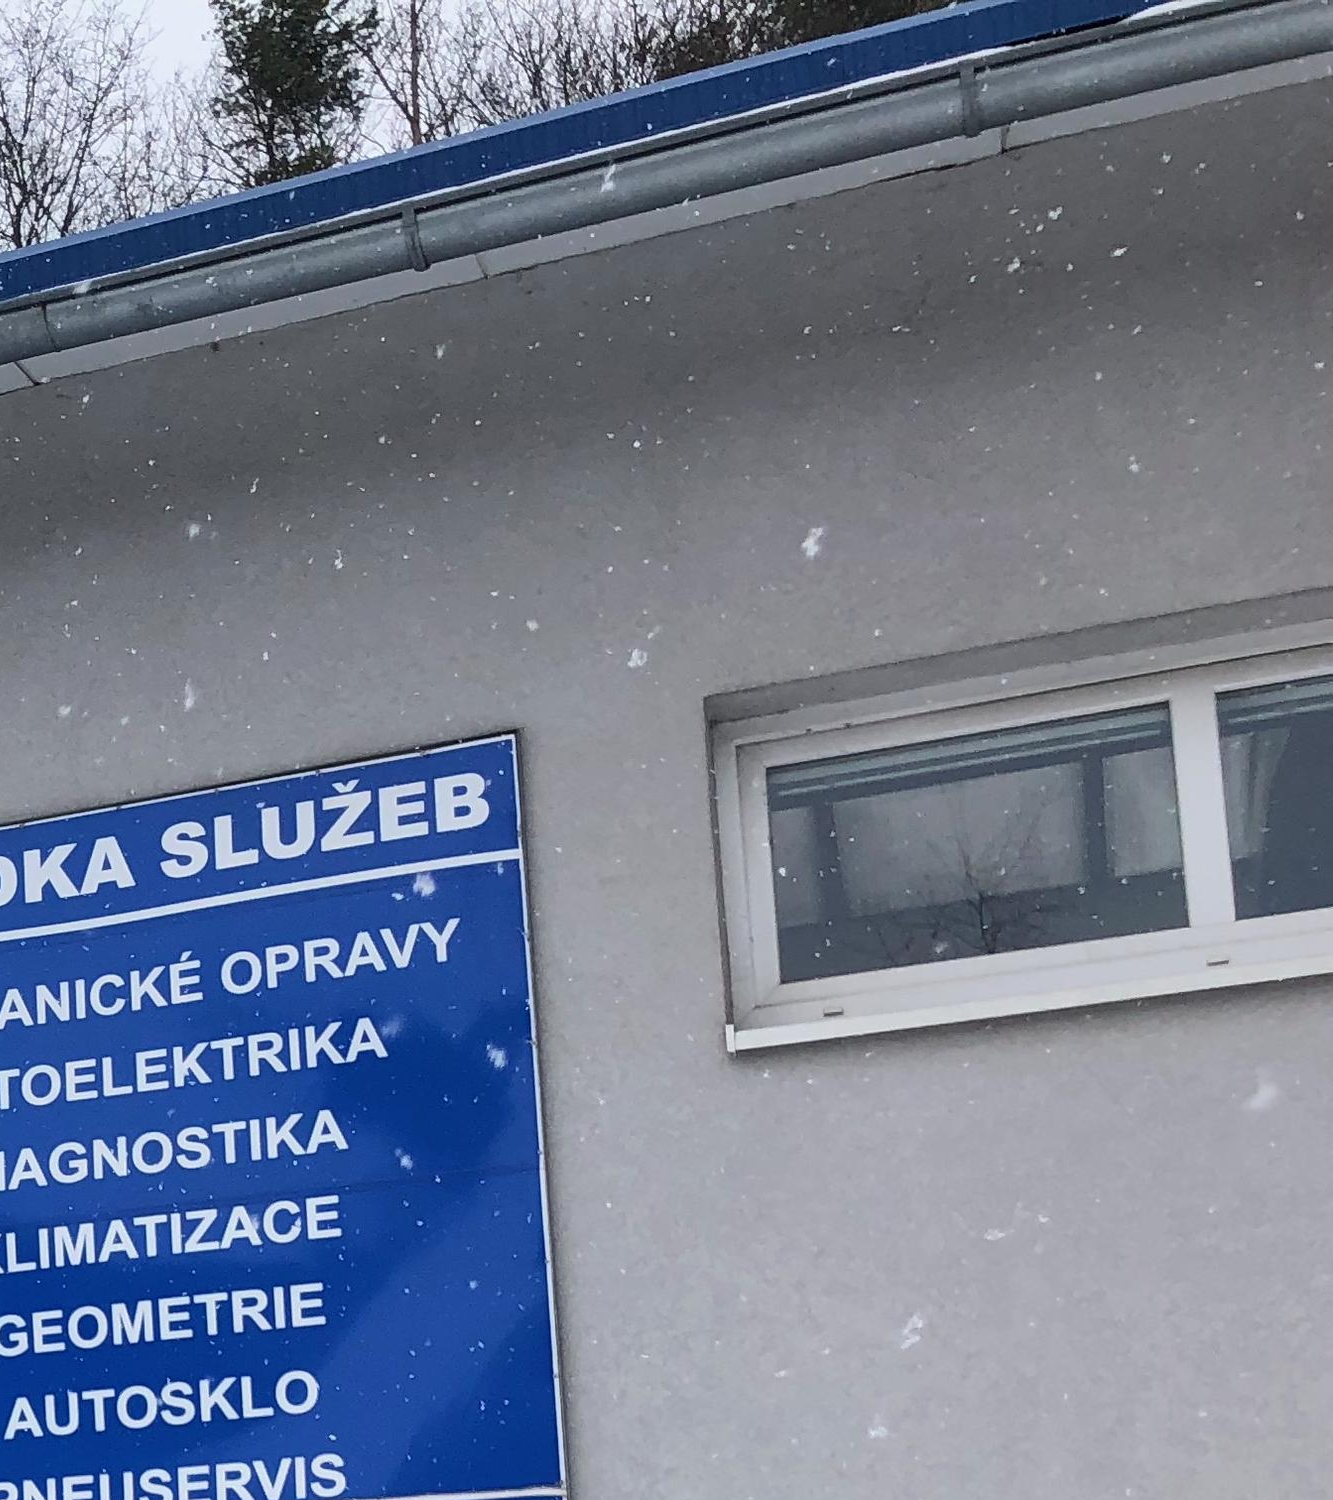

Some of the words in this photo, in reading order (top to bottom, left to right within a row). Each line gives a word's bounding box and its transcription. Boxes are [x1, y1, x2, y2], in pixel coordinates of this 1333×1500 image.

[161, 771, 489, 878] SLUŽEB
[222, 918, 459, 994] OPRAVY
[5, 1371, 319, 1439] AUTOSKLO
